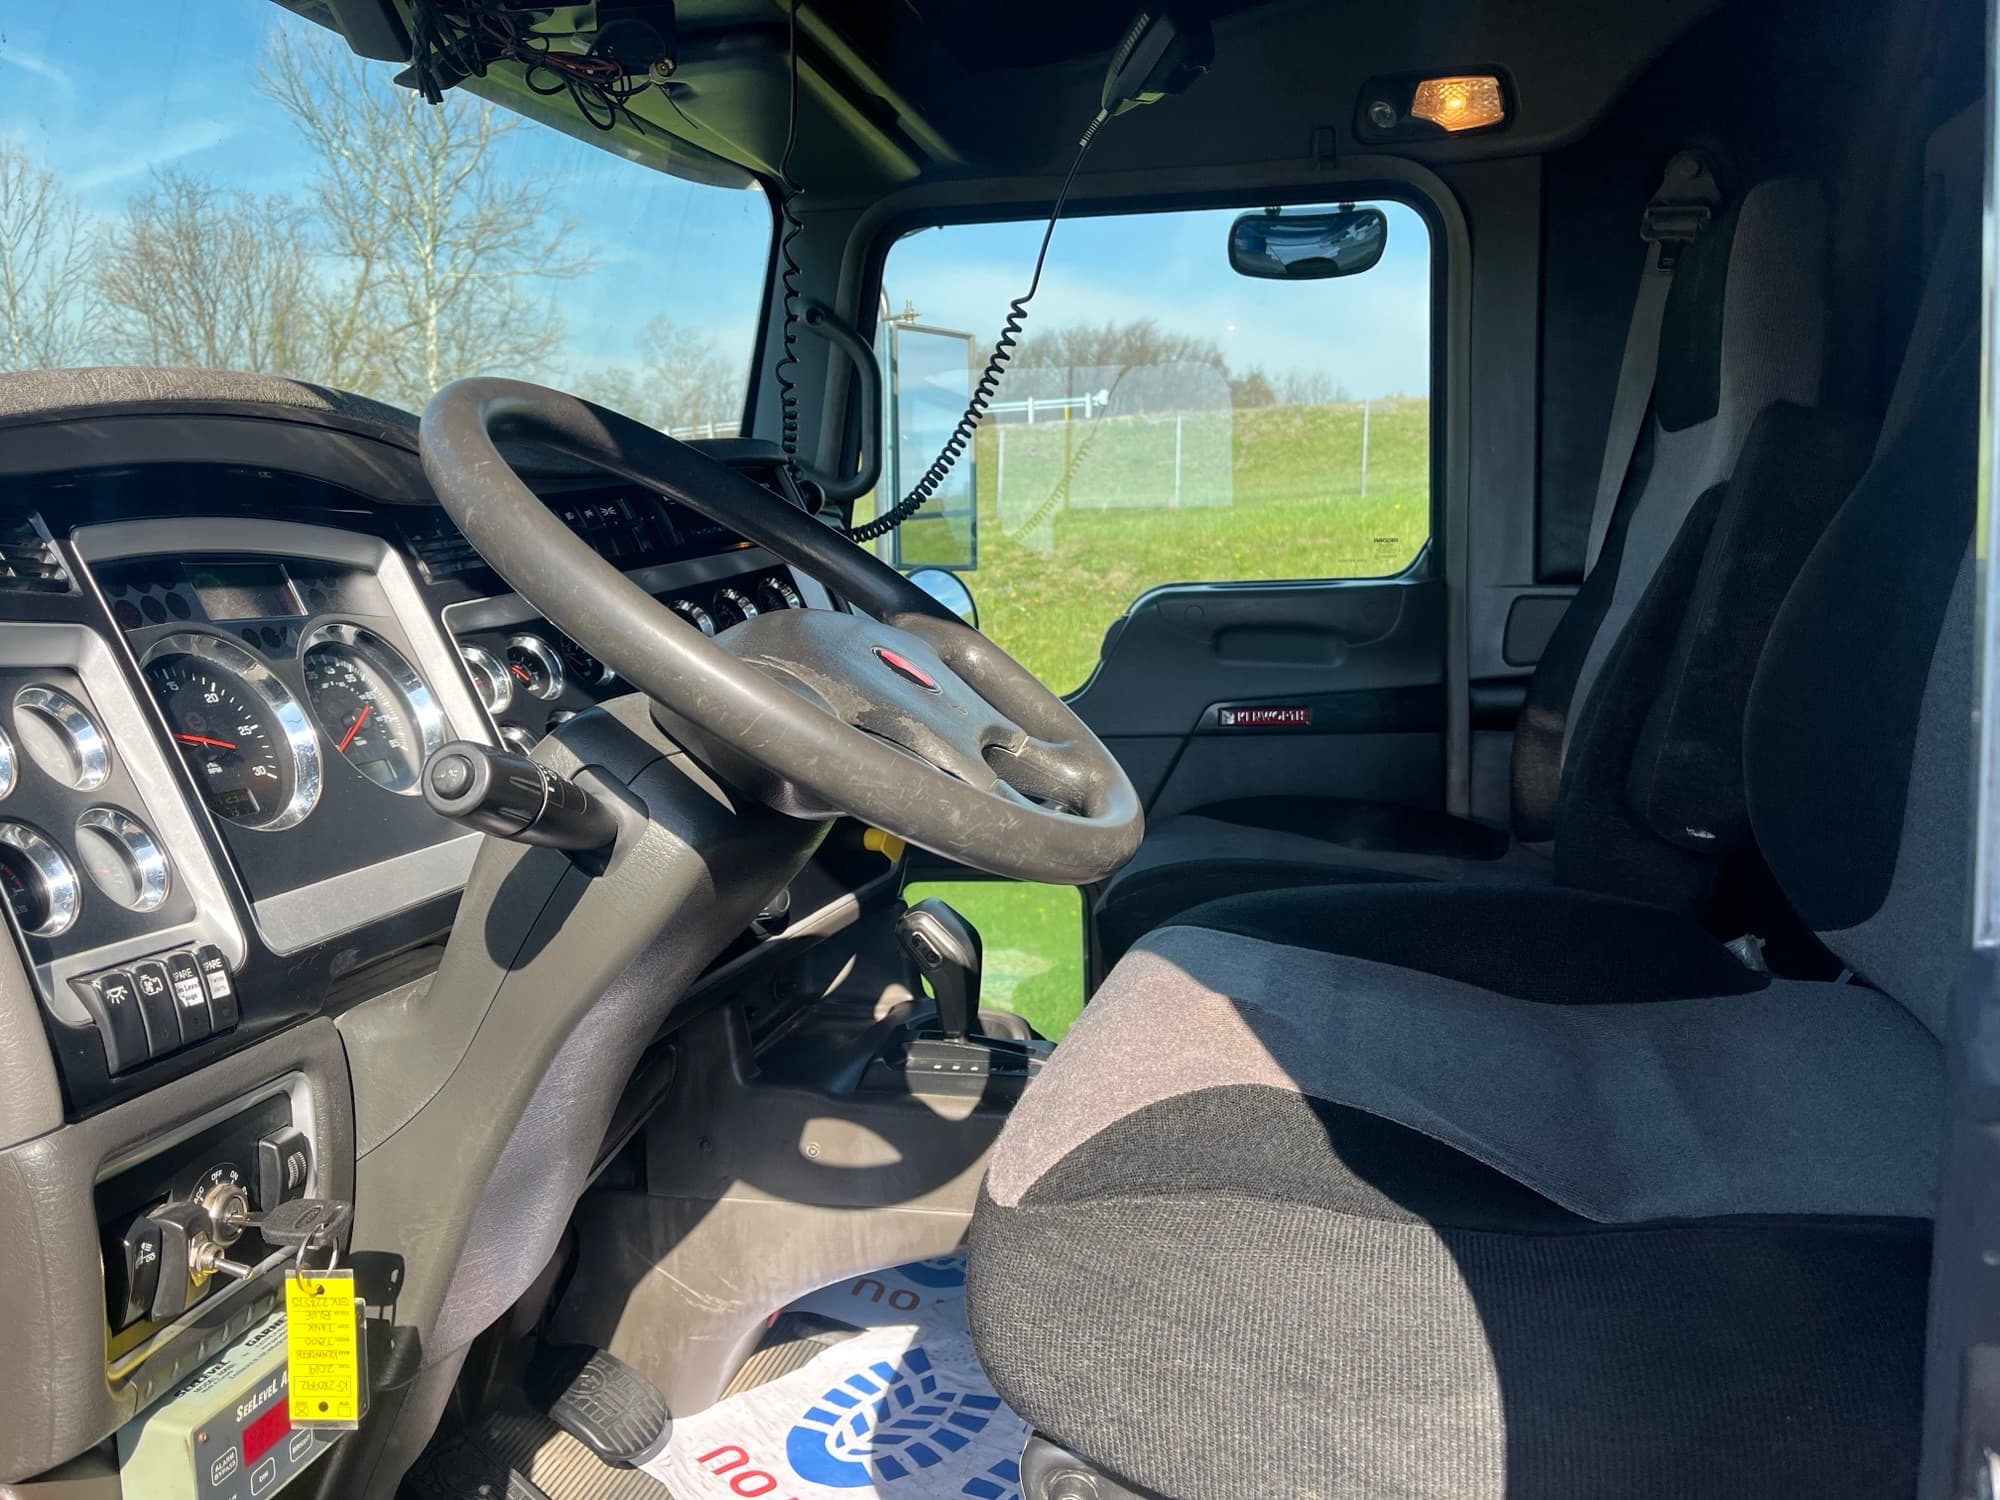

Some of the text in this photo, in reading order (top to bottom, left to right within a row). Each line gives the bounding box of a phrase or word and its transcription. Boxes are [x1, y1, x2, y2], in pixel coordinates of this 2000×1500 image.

[166, 680, 180, 691] 15
[204, 692, 219, 703] 20
[237, 725, 252, 736] 25
[252, 766, 266, 776] 30
[211, 1169, 222, 1181] OFF
[229, 1170, 239, 1181] ON
[193, 1186, 204, 1204] ACC
[850, 1276, 920, 1311] OU
[305, 1310, 331, 1320] BLUE
[246, 1314, 287, 1346] GARNE
[309, 1364, 334, 1374] 2019
[215, 1452, 235, 1472] ALARM
[214, 1460, 236, 1481] BYPASS
[696, 1444, 778, 1499] OU
